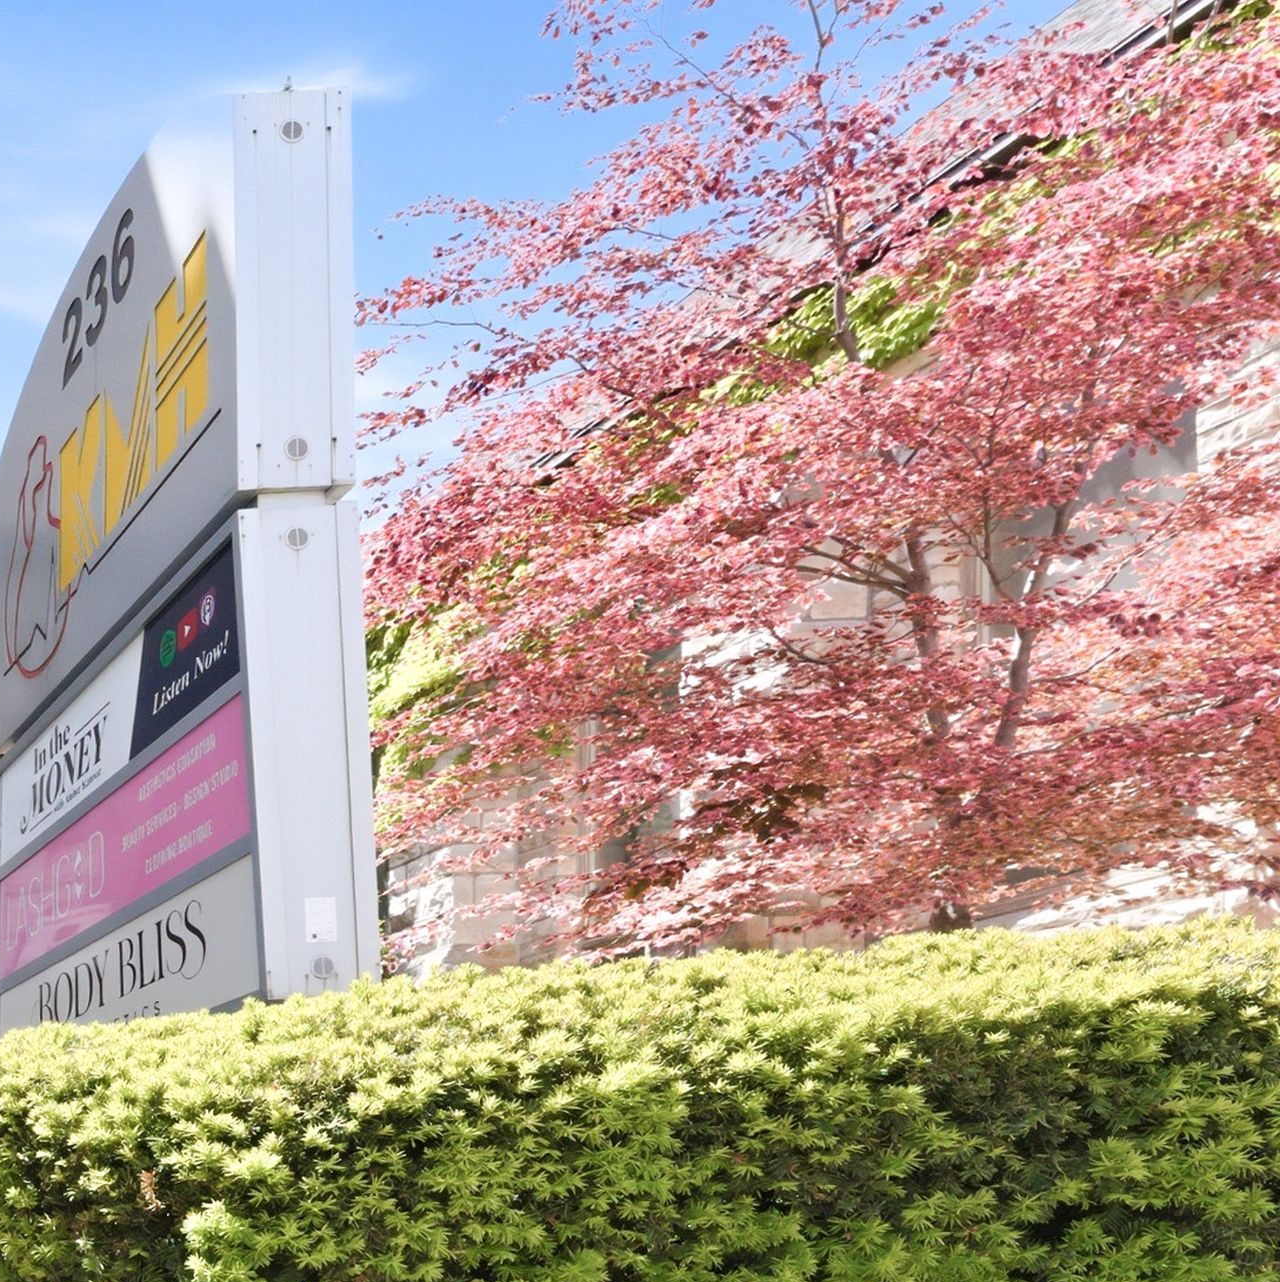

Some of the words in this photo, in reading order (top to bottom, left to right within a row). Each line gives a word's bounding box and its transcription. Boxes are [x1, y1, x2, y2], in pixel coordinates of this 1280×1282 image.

[62, 208, 134, 390] 236
[152, 671, 190, 716] Listen
[193, 629, 230, 680] Now!
[20, 714, 108, 835] MONEY
[34, 747, 47, 775] In
[49, 724, 71, 760] the
[32, 949, 109, 1026] BODY
[117, 899, 207, 999] BLISS
